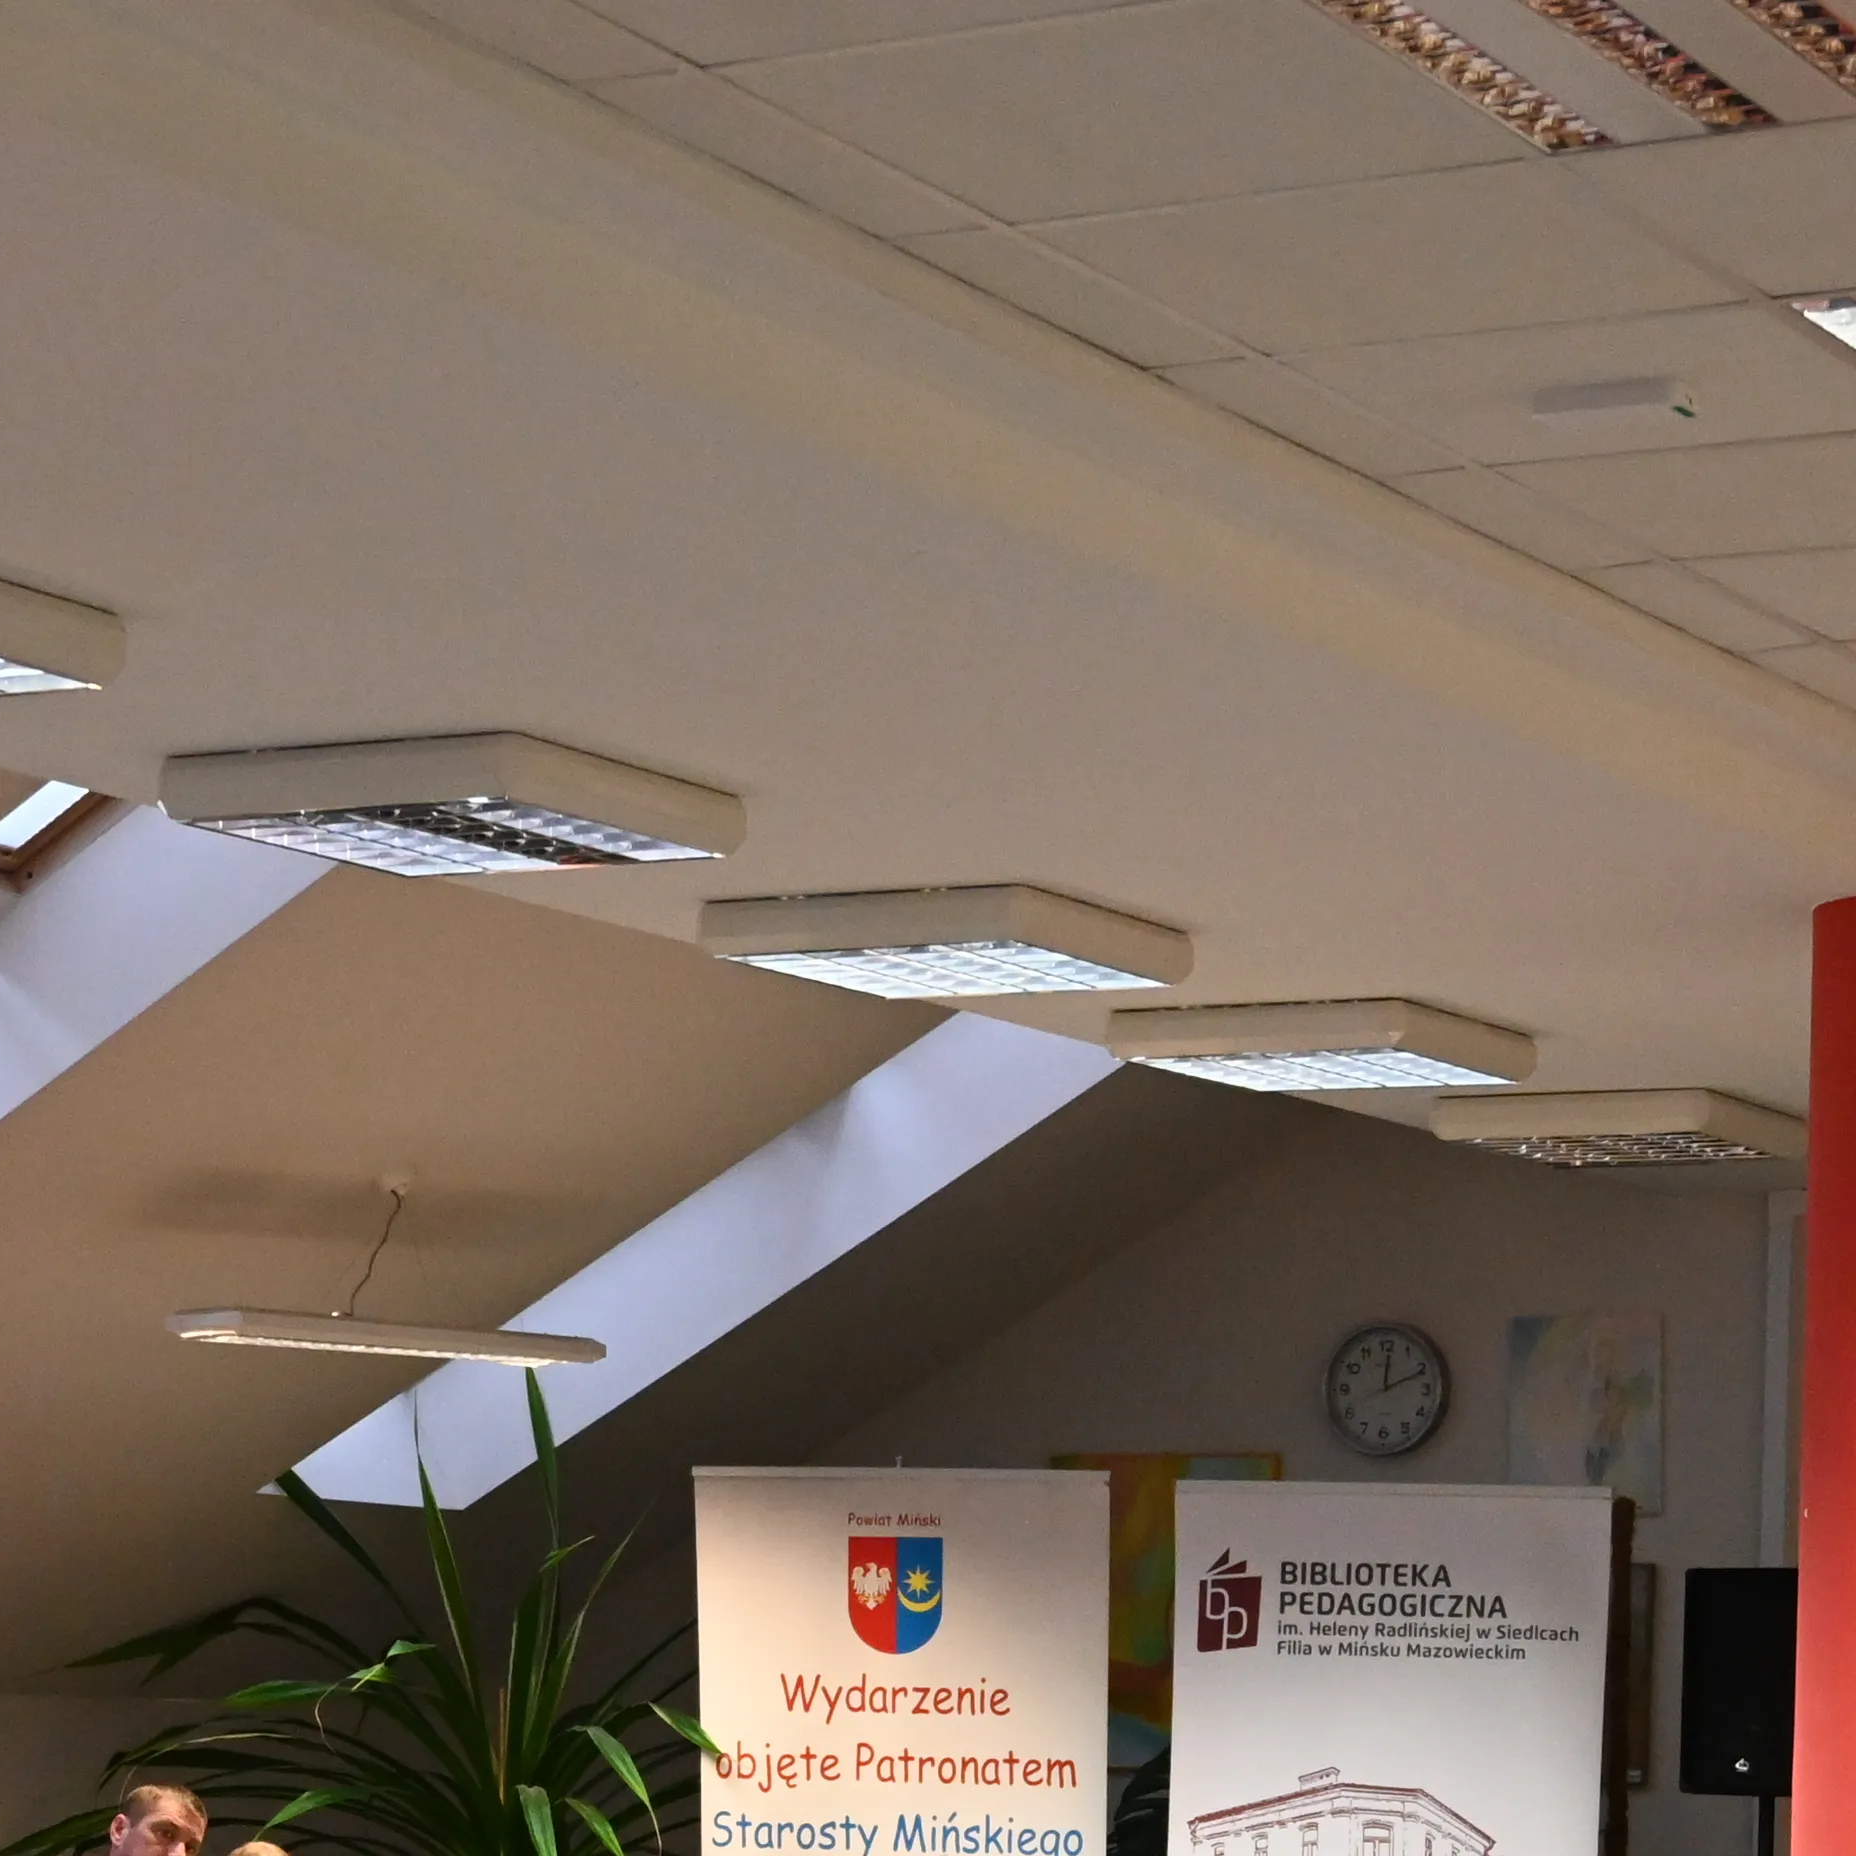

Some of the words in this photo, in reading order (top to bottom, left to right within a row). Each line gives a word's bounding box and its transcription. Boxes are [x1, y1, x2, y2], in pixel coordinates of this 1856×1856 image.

[847, 1511, 892, 1527] Powiat
[896, 1511, 942, 1527] Miński
[1279, 1561, 1452, 1588] BIBLIOTEKA
[1278, 1591, 1508, 1619] PEDAGOGICZNA
[1277, 1619, 1303, 1636] im.
[1309, 1620, 1369, 1640] Heleny
[1374, 1621, 1471, 1642] Radlińskiej
[1476, 1627, 1492, 1640] w
[1495, 1623, 1580, 1642] Siedlcach
[1277, 1640, 1312, 1656] Filia
[1318, 1644, 1332, 1656] w
[1337, 1640, 1401, 1658] Mińsku
[1406, 1642, 1526, 1660] Mazowieckim
[780, 1672, 1011, 1725] Wydarzenie
[715, 1740, 841, 1793] objęte
[854, 1742, 1078, 1789] Patronatem
